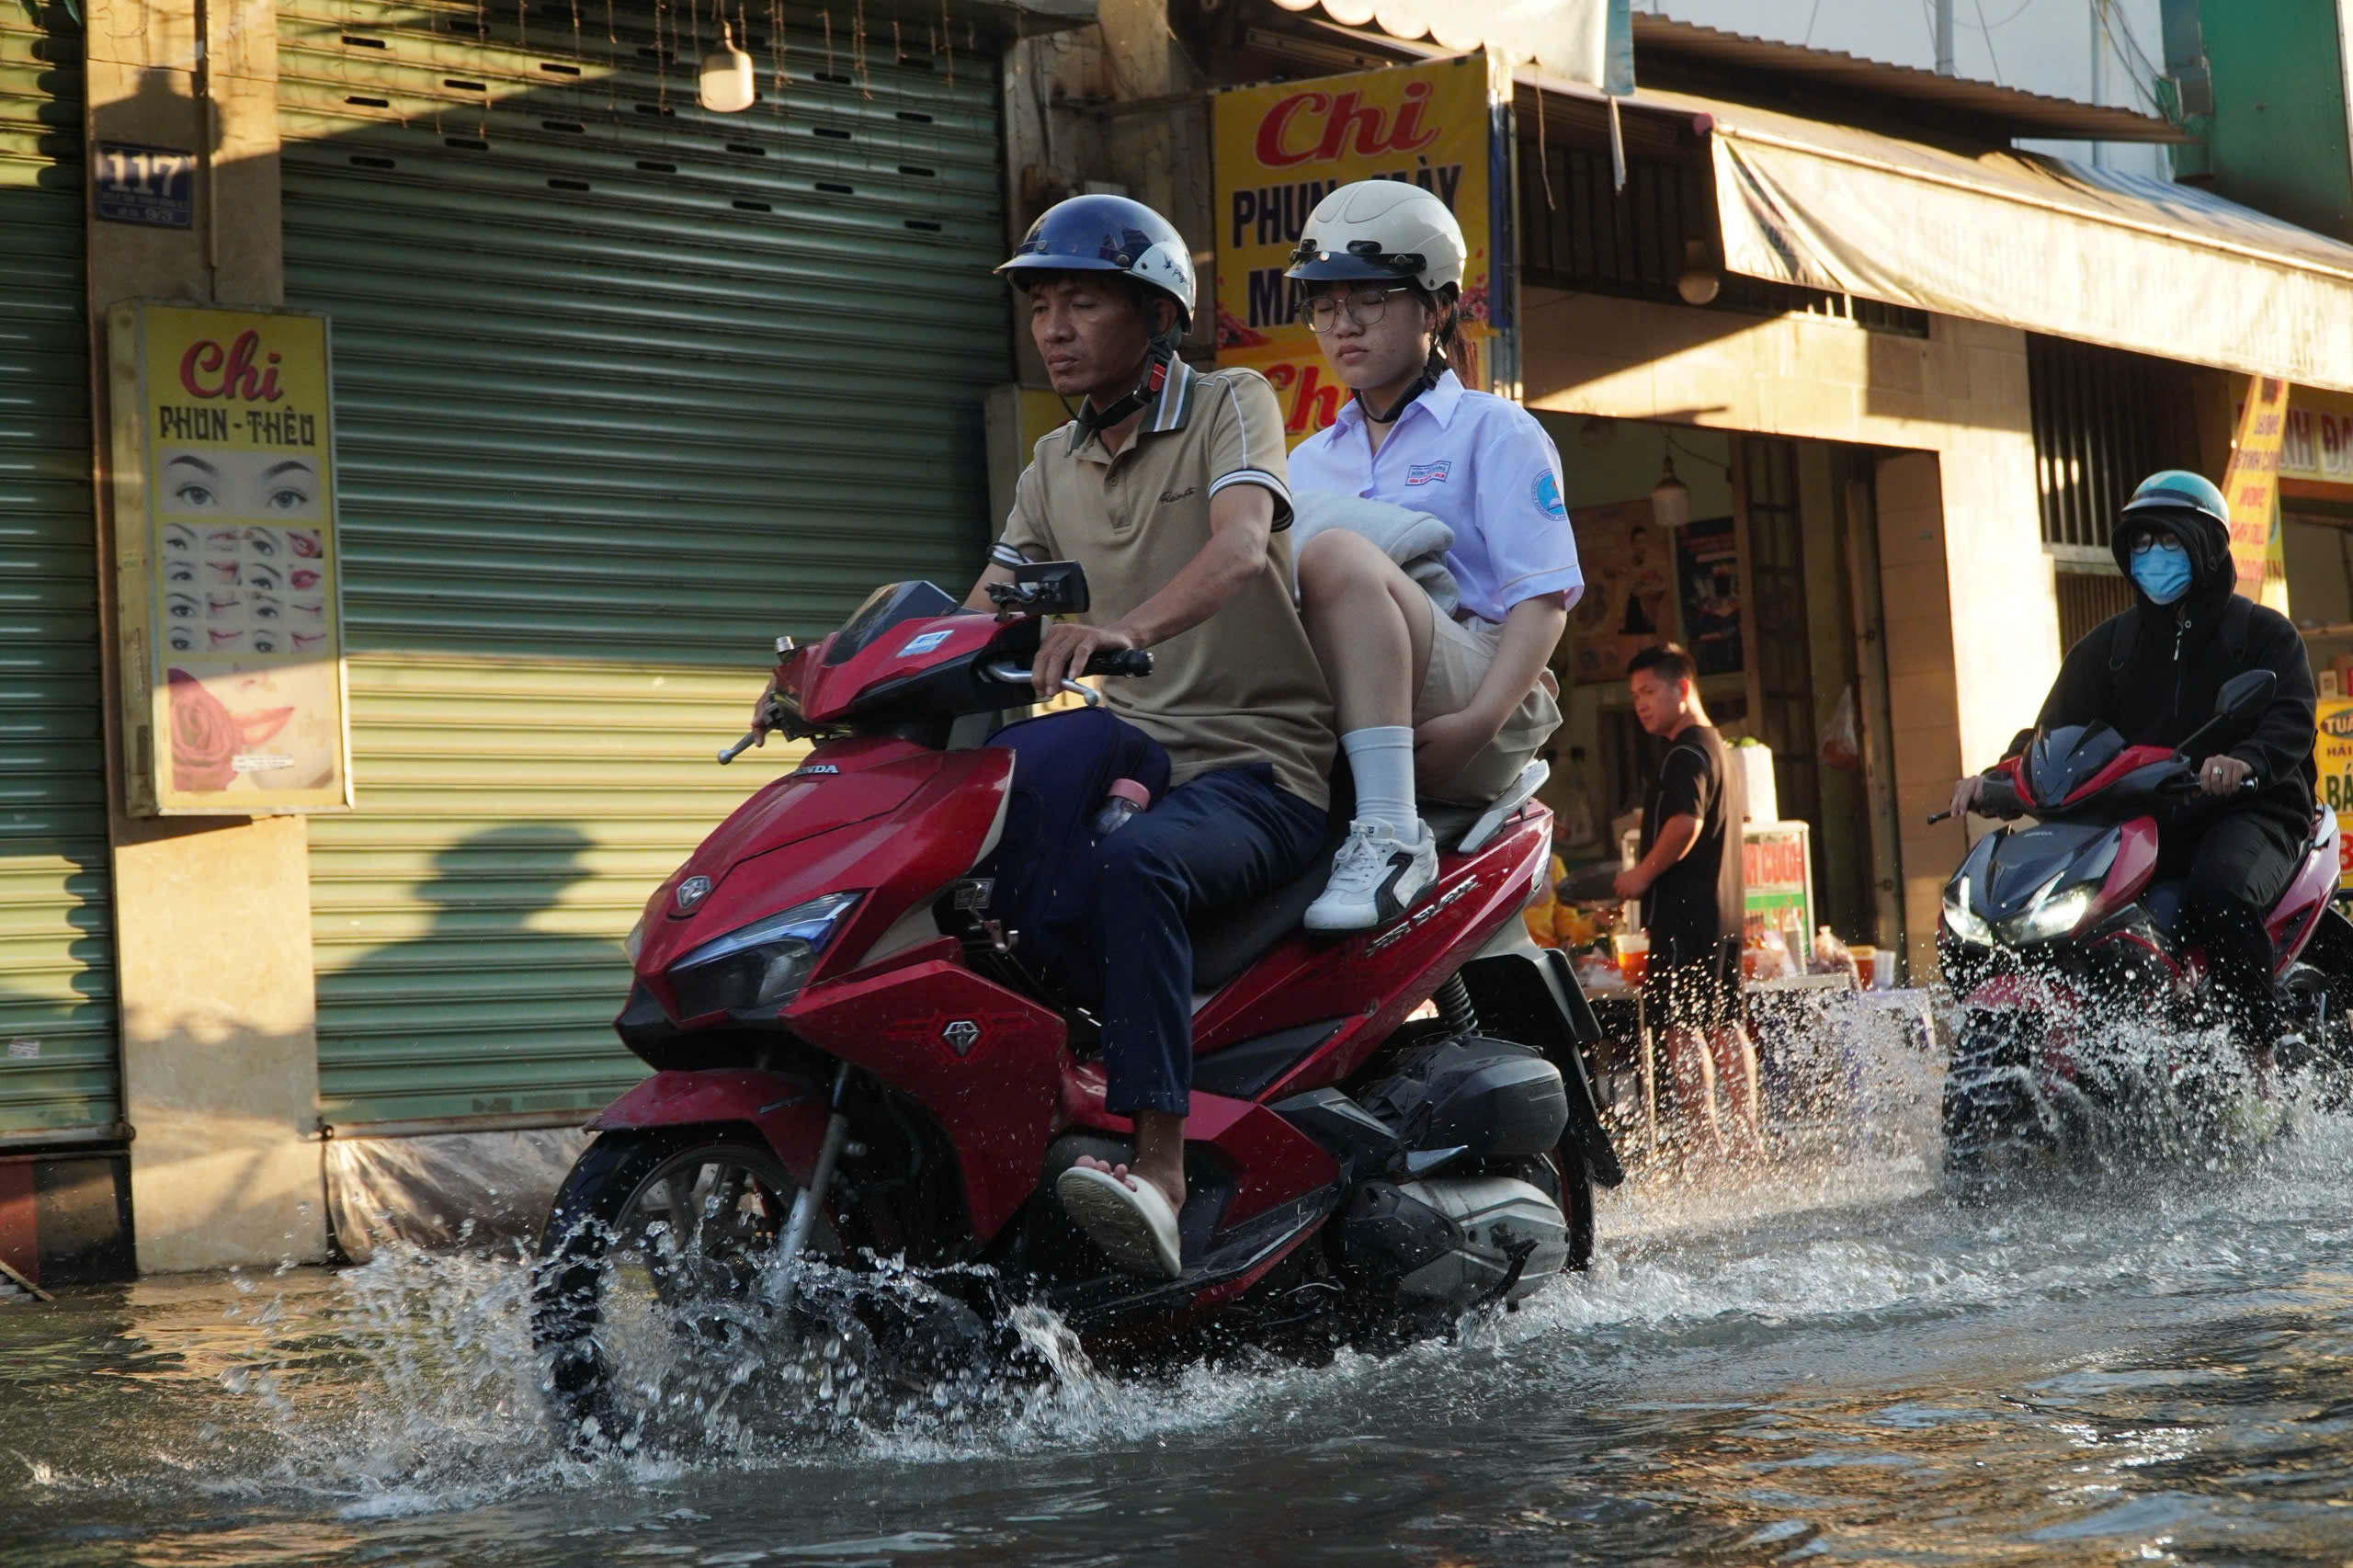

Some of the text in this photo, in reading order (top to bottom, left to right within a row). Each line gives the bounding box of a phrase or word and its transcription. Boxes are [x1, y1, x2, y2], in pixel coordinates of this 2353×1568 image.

[1255, 80, 1441, 168] Chi
[107, 152, 183, 198] 117
[179, 329, 284, 403] Chi
[1262, 363, 1355, 437] Ch
